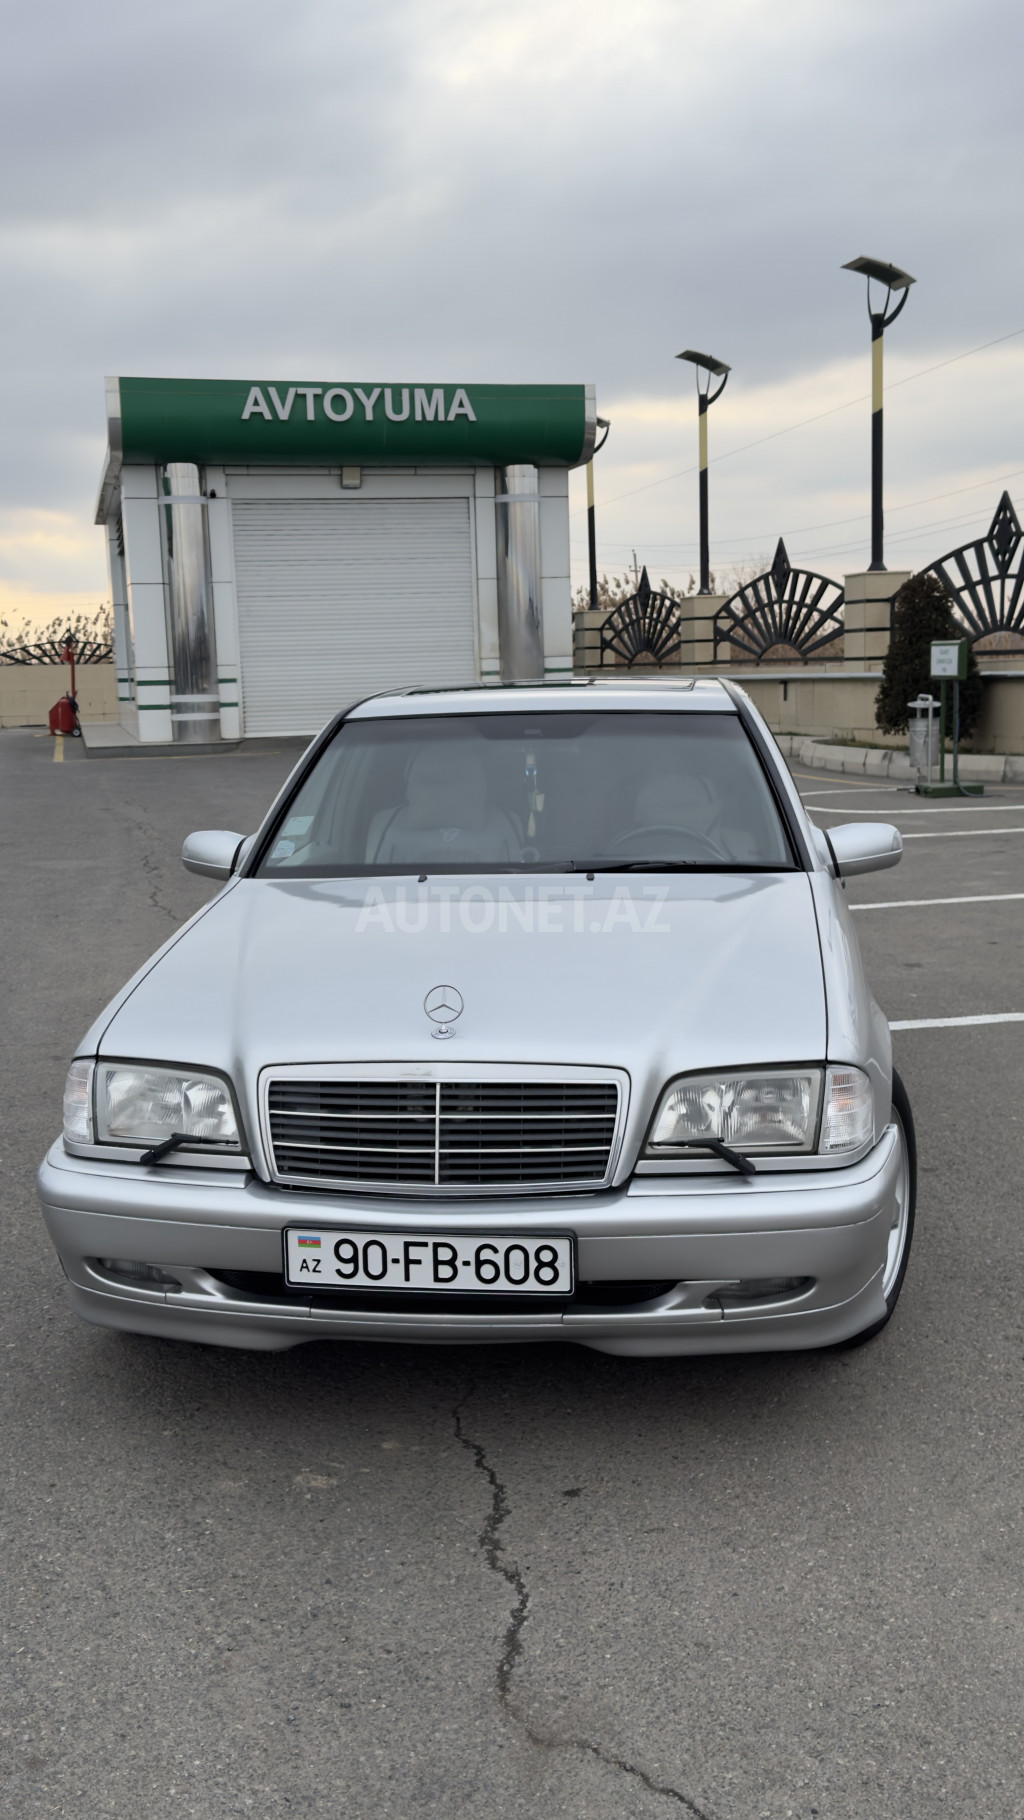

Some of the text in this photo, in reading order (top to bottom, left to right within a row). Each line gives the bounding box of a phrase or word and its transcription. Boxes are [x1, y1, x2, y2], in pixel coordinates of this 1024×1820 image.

[241, 386, 477, 422] AVTOYUMA
[299, 1258, 322, 1273] AZ
[333, 1238, 560, 1286] 90-FB-608
